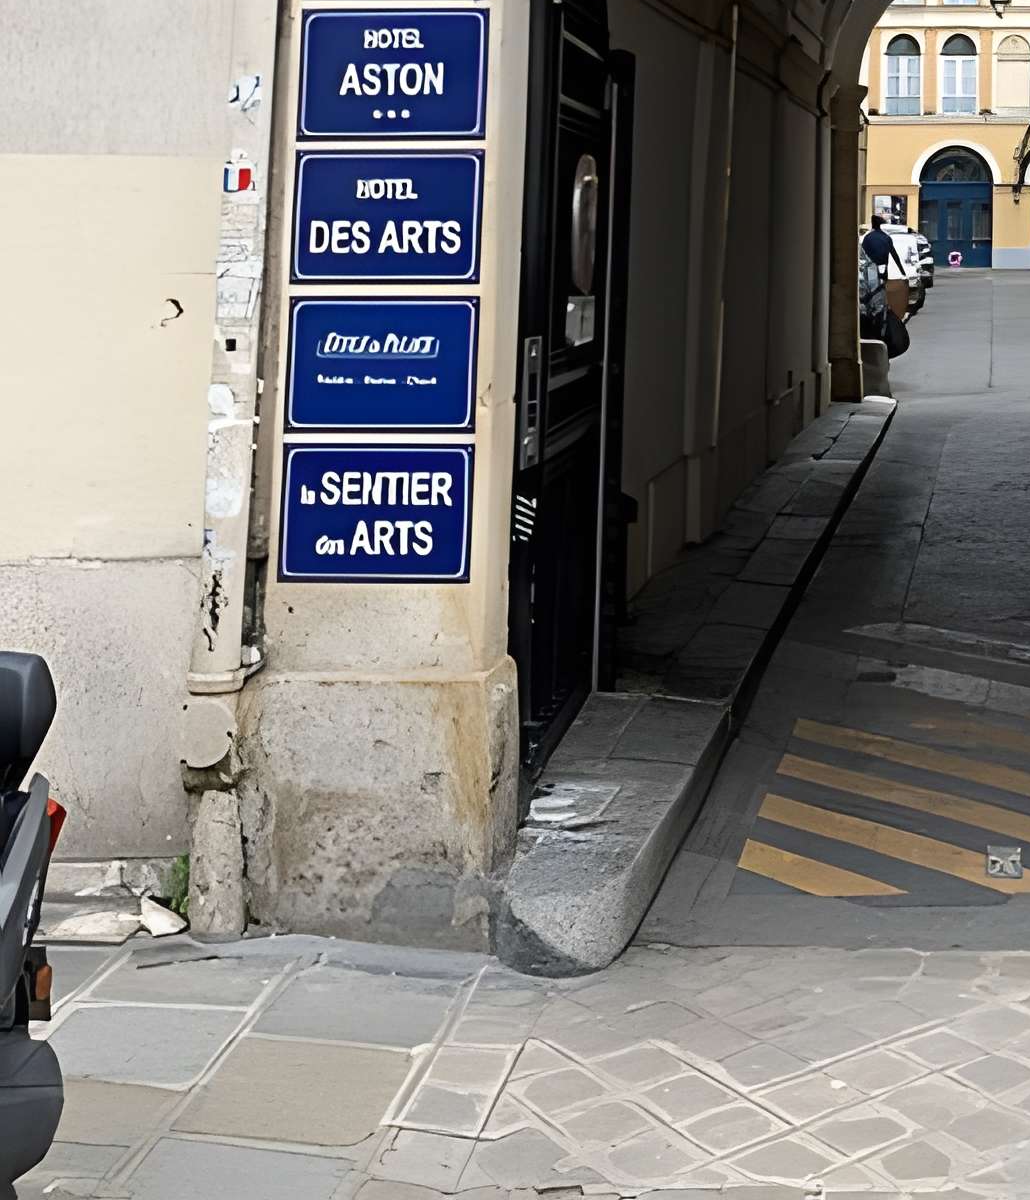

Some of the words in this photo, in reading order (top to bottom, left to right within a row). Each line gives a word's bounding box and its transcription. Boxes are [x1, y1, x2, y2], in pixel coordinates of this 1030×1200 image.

[339, 62, 445, 96] ASTON
[309, 220, 371, 254] DES
[377, 220, 461, 255] ARTS
[319, 471, 453, 507] SENTIER
[349, 520, 433, 556] ARTS
